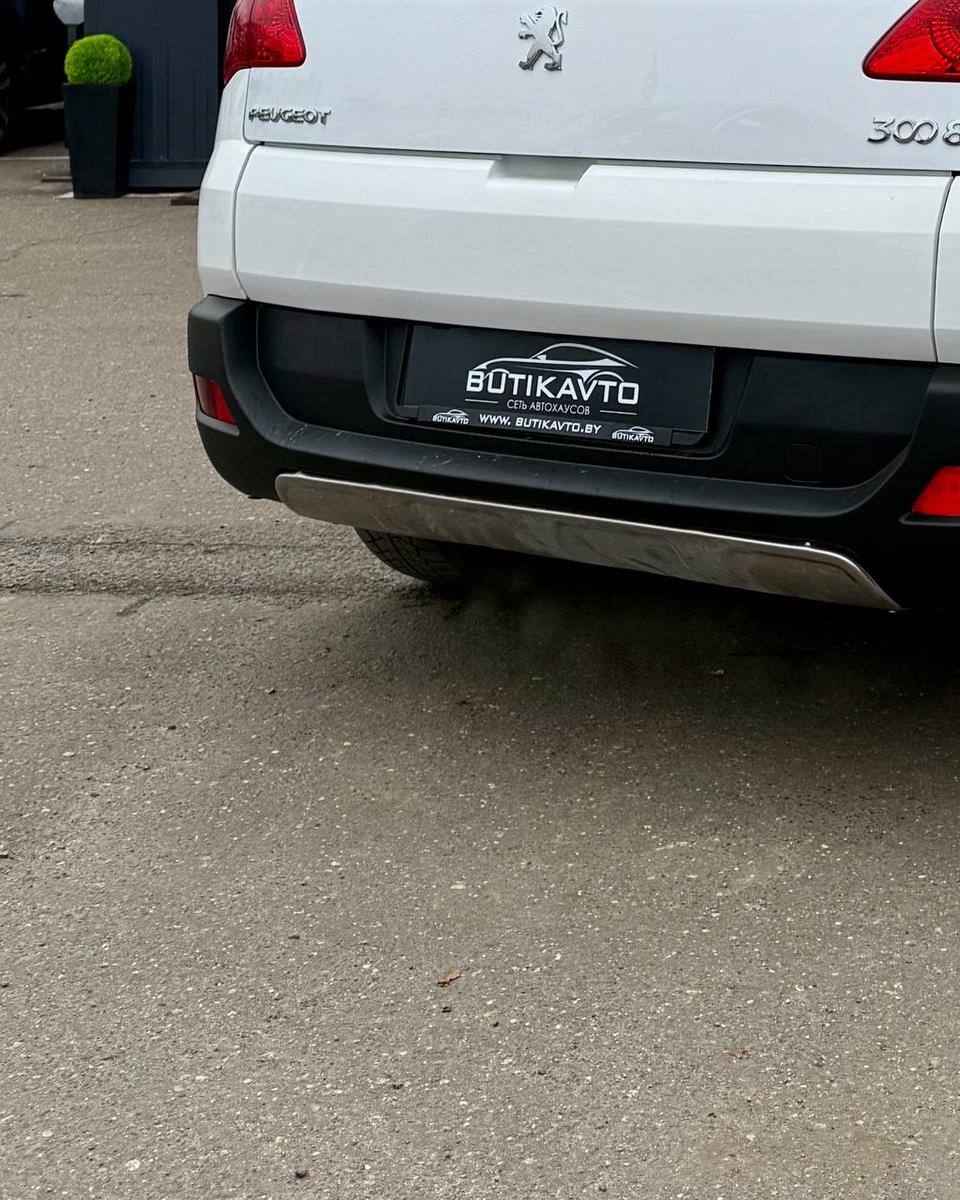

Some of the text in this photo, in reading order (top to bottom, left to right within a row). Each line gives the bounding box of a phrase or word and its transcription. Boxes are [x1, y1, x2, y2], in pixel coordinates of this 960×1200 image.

[249, 108, 331, 125] PEUGEOT
[466, 370, 640, 405] BUTIKAVTO
[506, 398, 591, 416] СЕТЬ АВТОХАУСОВ
[479, 413, 602, 435] WWW. BUTIKAVTO.BY
